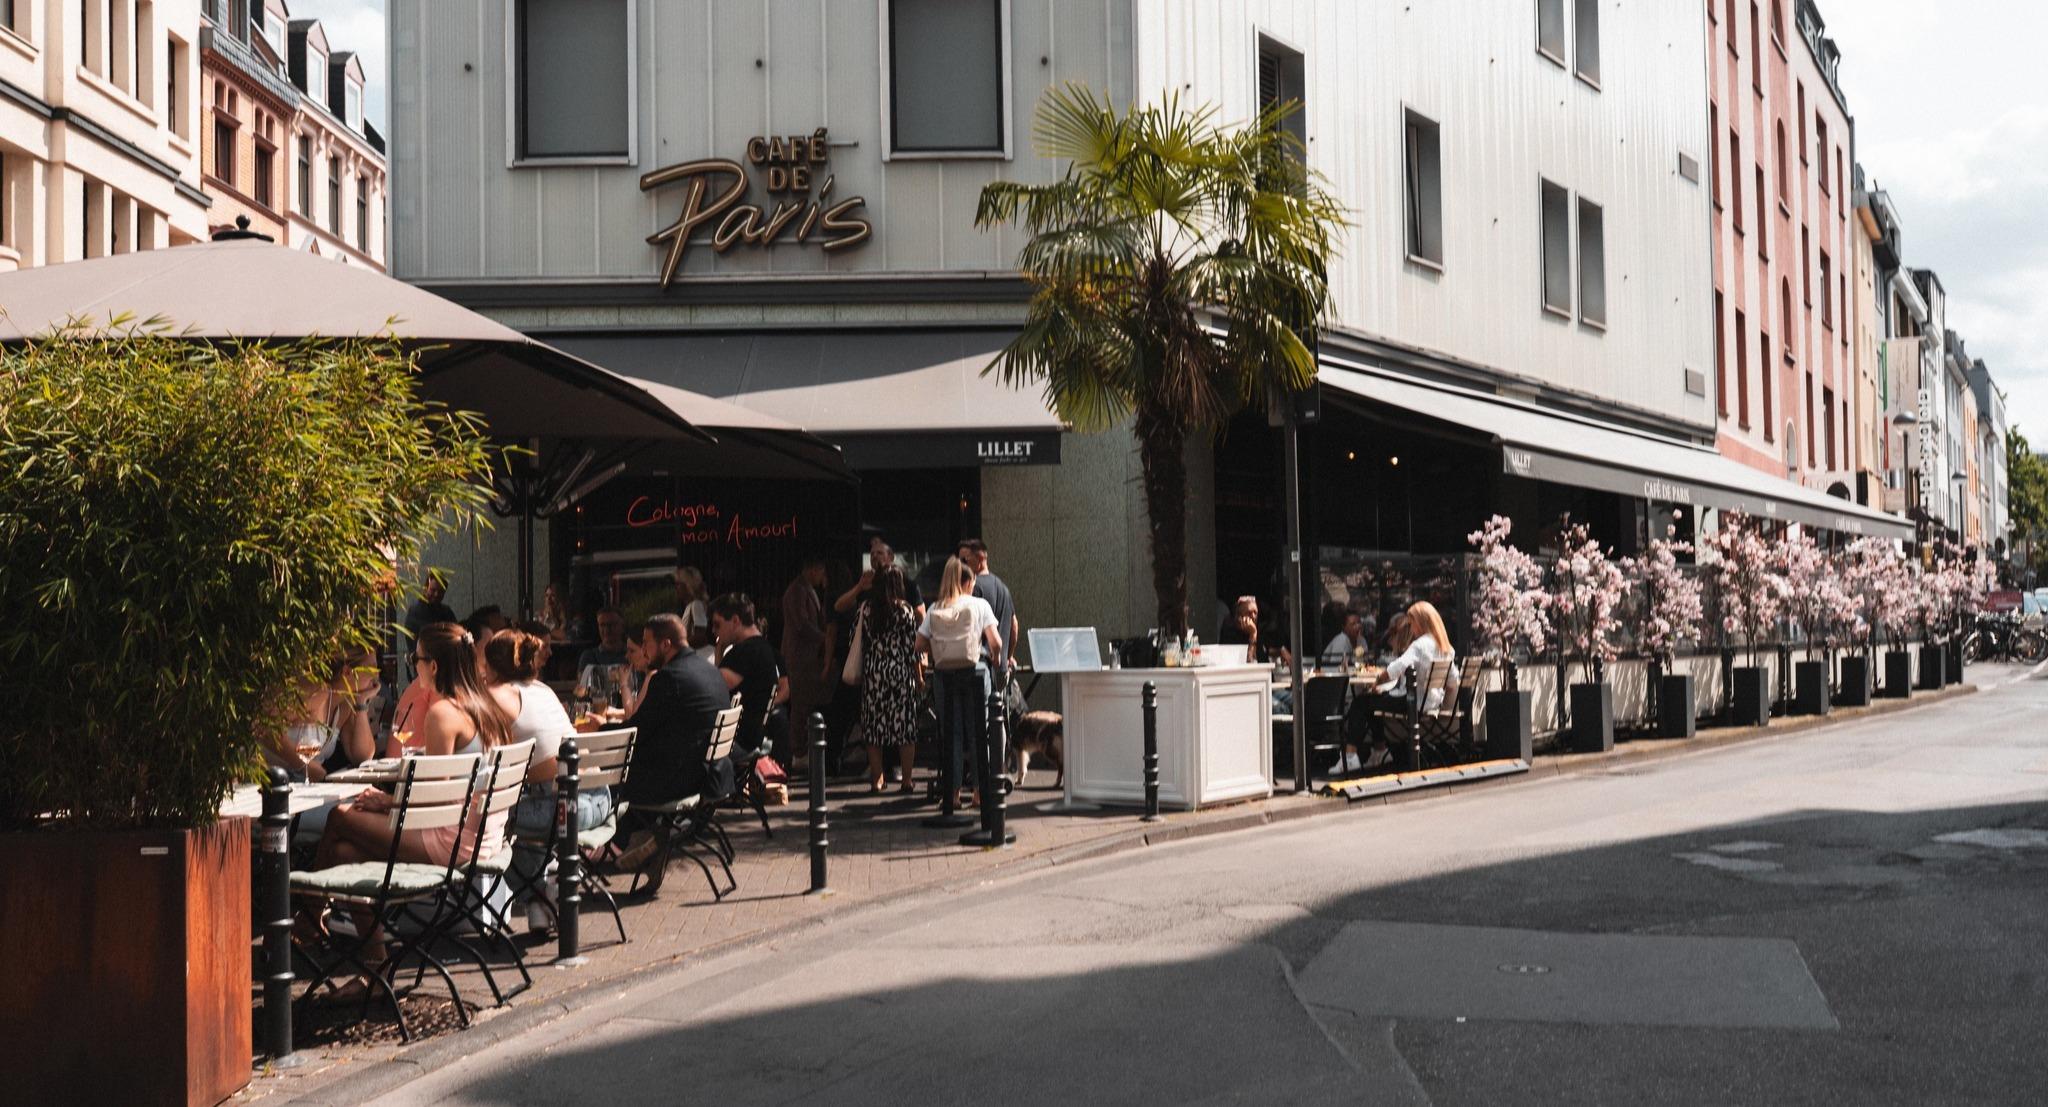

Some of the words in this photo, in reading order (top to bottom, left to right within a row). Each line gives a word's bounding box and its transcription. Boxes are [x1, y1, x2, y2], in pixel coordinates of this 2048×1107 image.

[748, 127, 828, 163] CAFÉ
[767, 165, 810, 193] DE
[640, 157, 872, 288] Paris
[977, 441, 1034, 456] LILLET
[1644, 478, 1662, 499] CAFÉ
[1662, 484, 1672, 501] DE
[1672, 486, 1690, 504] PARIS
[682, 530, 719, 544] mon
